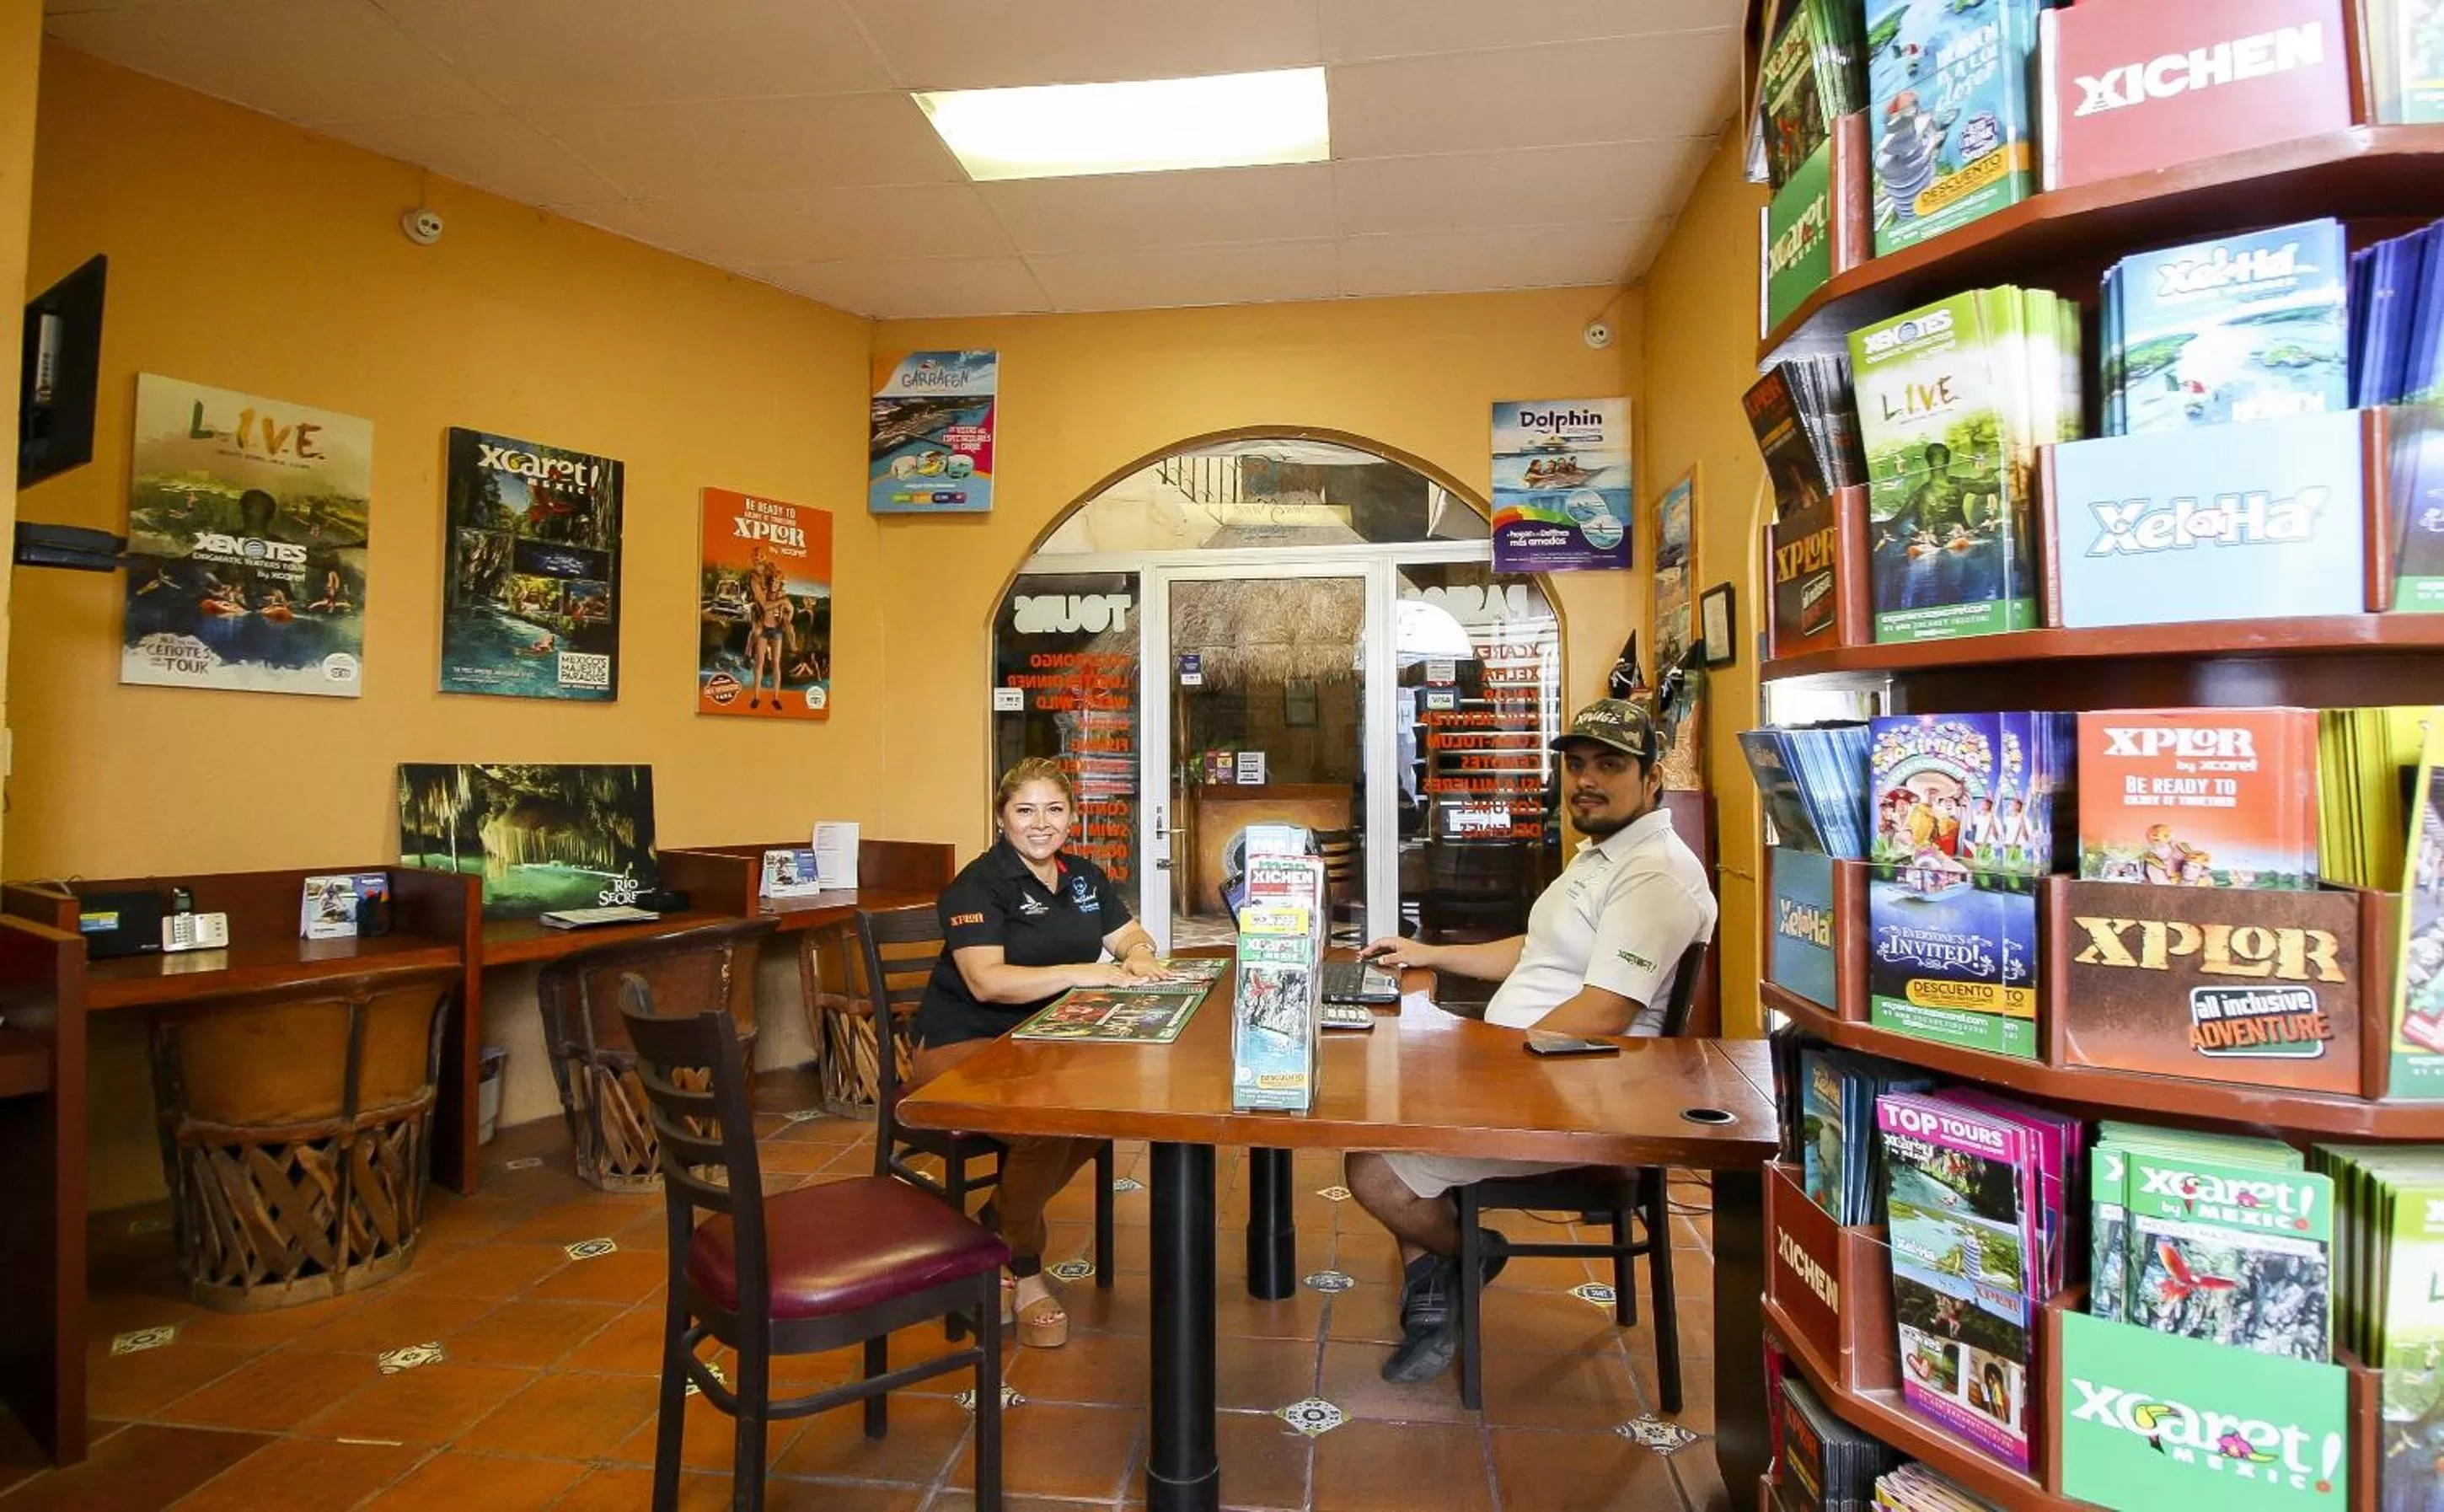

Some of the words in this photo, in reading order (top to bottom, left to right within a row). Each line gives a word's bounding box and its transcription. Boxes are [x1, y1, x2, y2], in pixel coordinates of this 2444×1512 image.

[2073, 21, 2323, 117] XICHEN
[1921, 153, 2002, 202] DESCUENTO
[1520, 410, 1603, 433] Dolphin
[785, 507, 796, 519] TO
[192, 532, 307, 562] XENOTES
[733, 517, 807, 548] XPLOR
[2103, 727, 2257, 757] XPLOR
[2152, 778, 2211, 794] READY
[2213, 778, 2237, 795] TO
[1252, 871, 1315, 883] XICHEN
[599, 891, 638, 906] SECRE
[1890, 935, 1980, 968] INVITED!
[2073, 916, 2346, 984] XPLOR
[1914, 981, 1994, 998] DESCUENTO
[2195, 995, 2221, 1018] all
[2222, 989, 2312, 1016] inclusive
[2188, 1011, 2334, 1049] ADVENTURE
[1883, 1102, 1938, 1135] TOP
[1939, 1118, 2004, 1147] TOURS
[2161, 1200, 2182, 1218] by
[1777, 1225, 1838, 1315] XICHEN
[2071, 1378, 2342, 1493] xcaret!
